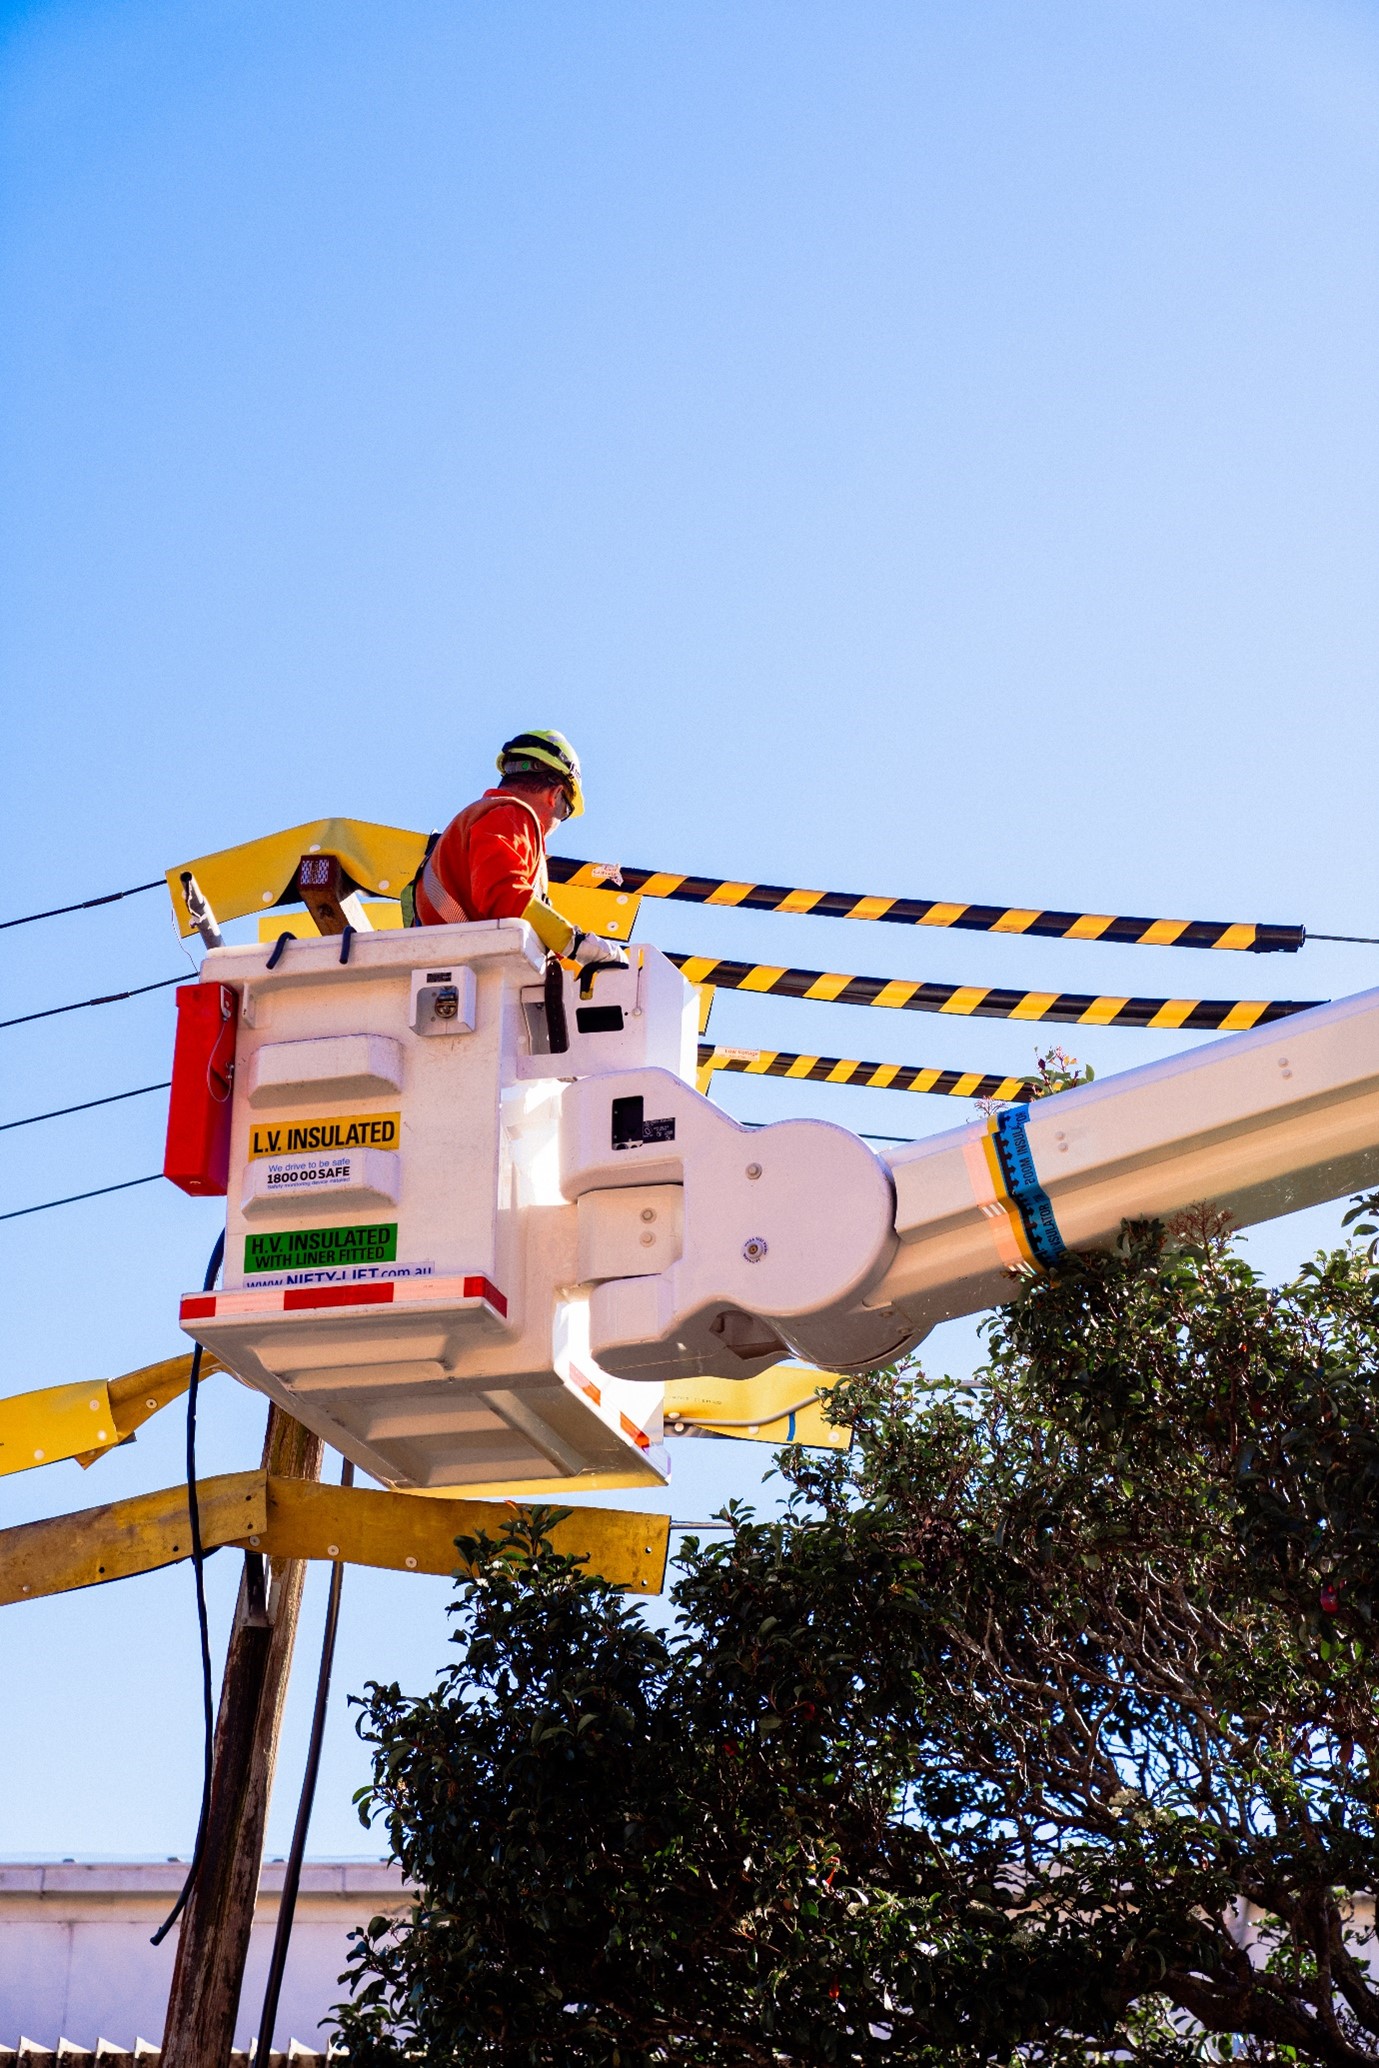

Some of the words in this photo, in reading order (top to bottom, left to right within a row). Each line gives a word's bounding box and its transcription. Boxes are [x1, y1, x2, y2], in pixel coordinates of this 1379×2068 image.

[253, 1130, 282, 1154] L.V.
[287, 1120, 395, 1150] INSULATED
[268, 1164, 282, 1173] We
[285, 1161, 306, 1171] drive
[308, 1160, 317, 1169] to
[319, 1159, 330, 1168] be
[332, 1157, 351, 1167] safe
[318, 1166, 351, 1179] SAFE
[252, 1235, 284, 1255] H.V.
[288, 1227, 391, 1251] INSULATED
[255, 1254, 292, 1269] WITH
[295, 1249, 335, 1266] LINER
[339, 1246, 385, 1262] FITTED
